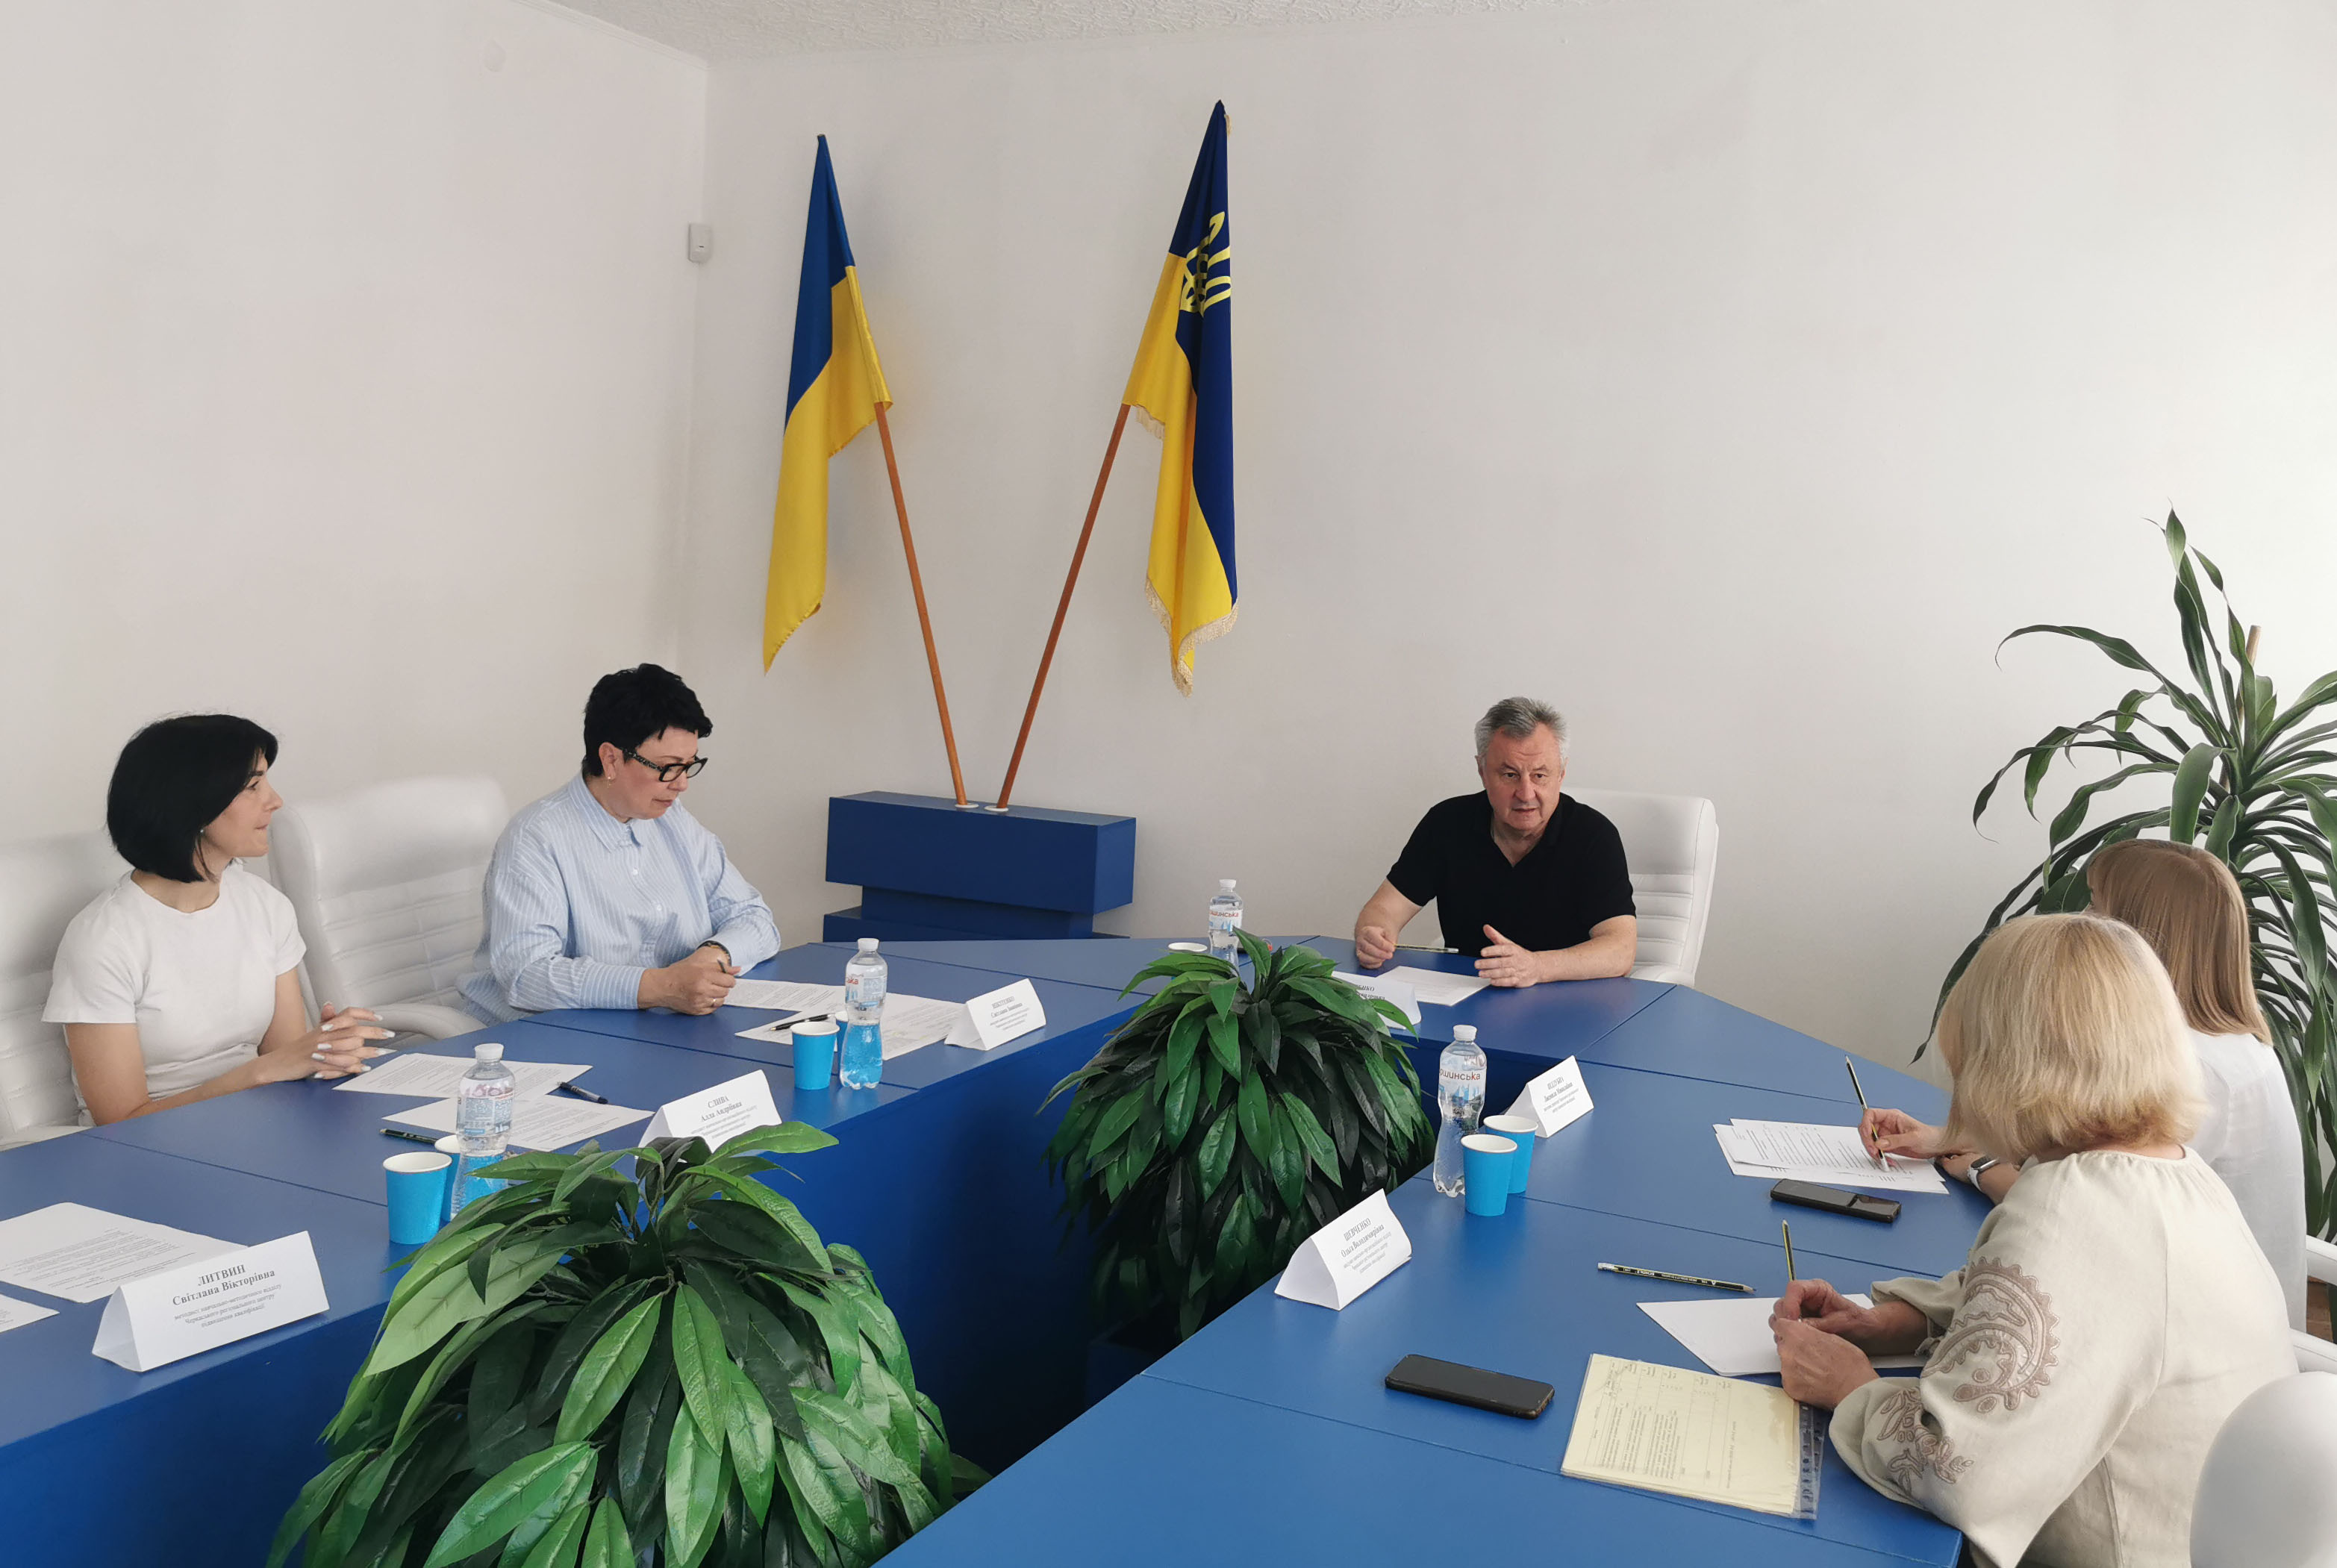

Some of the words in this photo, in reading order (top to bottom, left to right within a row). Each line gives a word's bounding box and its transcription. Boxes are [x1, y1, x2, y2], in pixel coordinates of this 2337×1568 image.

[1439, 1068, 1481, 1081] ршинська
[1343, 1217, 1371, 1242] ШЕВЧЕНКО
[198, 1264, 246, 1286] ЛИТВИН
[172, 1286, 219, 1306] Світлана
[222, 1269, 275, 1291] Вікторівна
